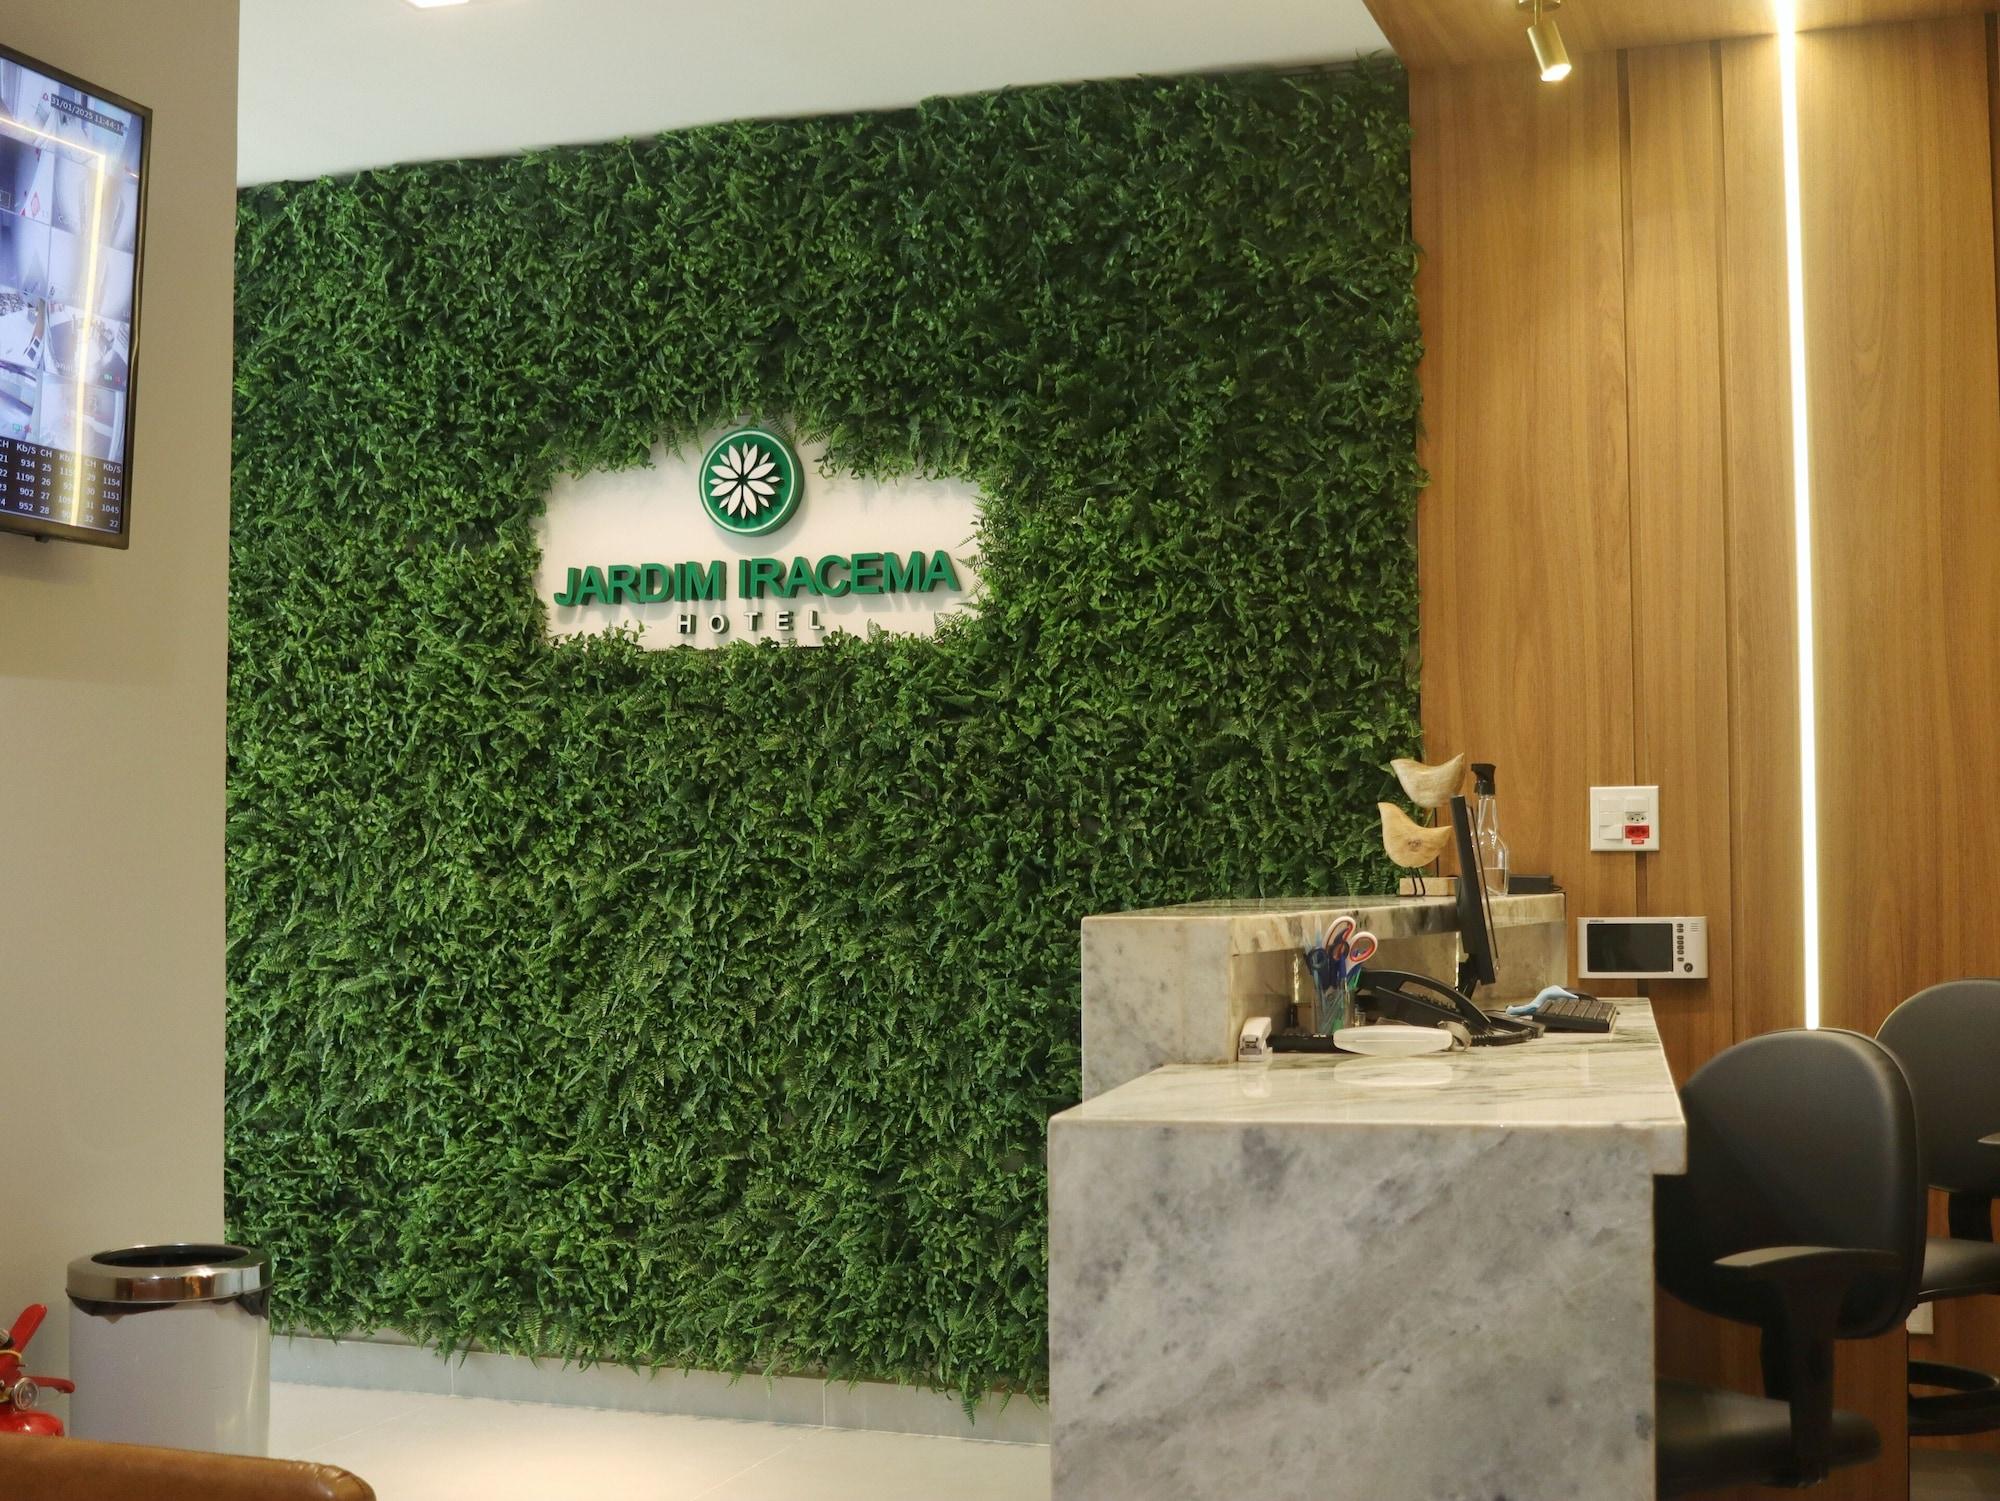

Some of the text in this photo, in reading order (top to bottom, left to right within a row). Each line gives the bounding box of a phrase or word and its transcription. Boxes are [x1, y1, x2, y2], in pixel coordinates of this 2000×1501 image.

[16, 443, 36, 455] Kb/S
[40, 448, 52, 458] CH
[103, 463, 121, 473] Kb/S
[20, 459, 35, 469] 934
[42, 463, 52, 472] 25
[103, 477, 121, 486] 1154
[16, 472, 35, 483] 1199
[41, 478, 51, 486] 26
[102, 490, 120, 501] 1151
[18, 502, 34, 512] 952
[40, 506, 50, 515] 28
[19, 487, 34, 497] 902
[40, 491, 50, 500] 27
[101, 504, 119, 514] 1045
[554, 550, 961, 607] JARDIM IRACEMA
[677, 610, 825, 635] HOTEL
